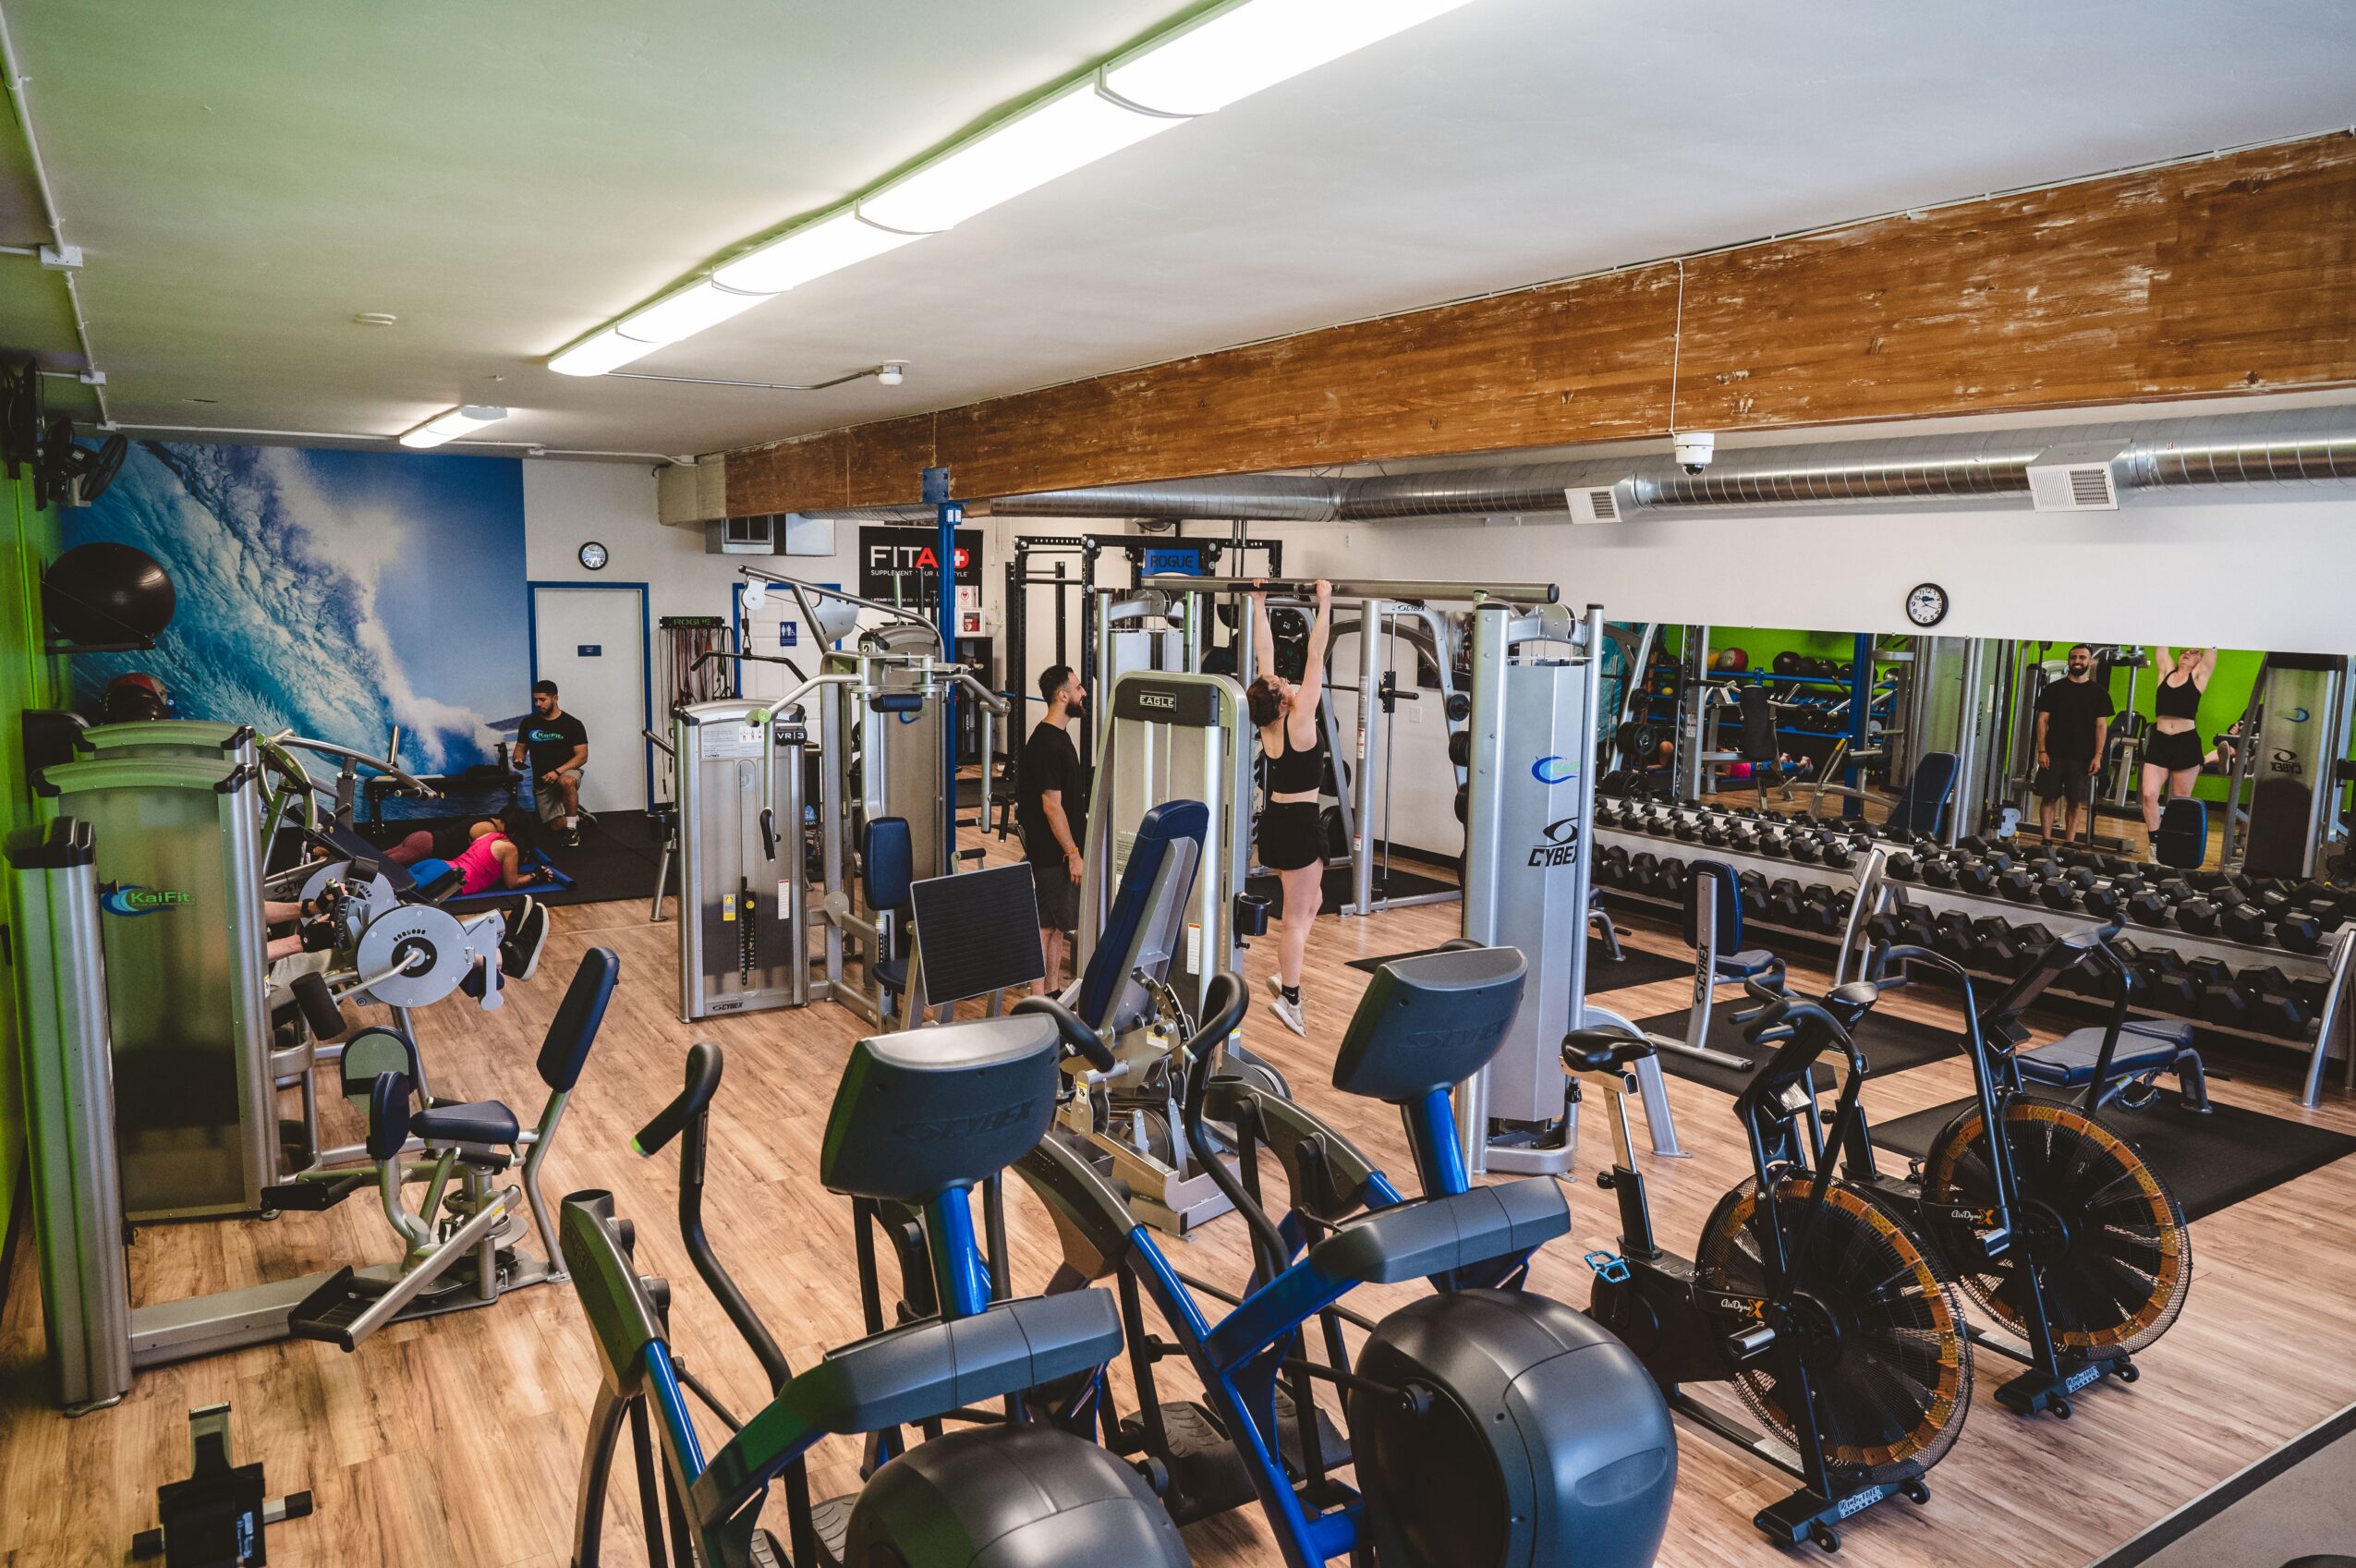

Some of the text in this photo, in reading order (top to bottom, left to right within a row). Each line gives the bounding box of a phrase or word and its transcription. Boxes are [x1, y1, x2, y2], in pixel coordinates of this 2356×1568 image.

[870, 545, 970, 568] FITAD
[1150, 554, 1194, 568] ROGUE
[674, 618, 711, 626] ROGUE
[1139, 694, 1175, 709] EAGLE
[777, 731, 805, 740] VR 3
[1527, 845, 1578, 868] CYBE
[130, 891, 191, 904] KaiFit
[1696, 940, 1709, 987] CYBEX
[721, 1002, 744, 1011] CYBEX
